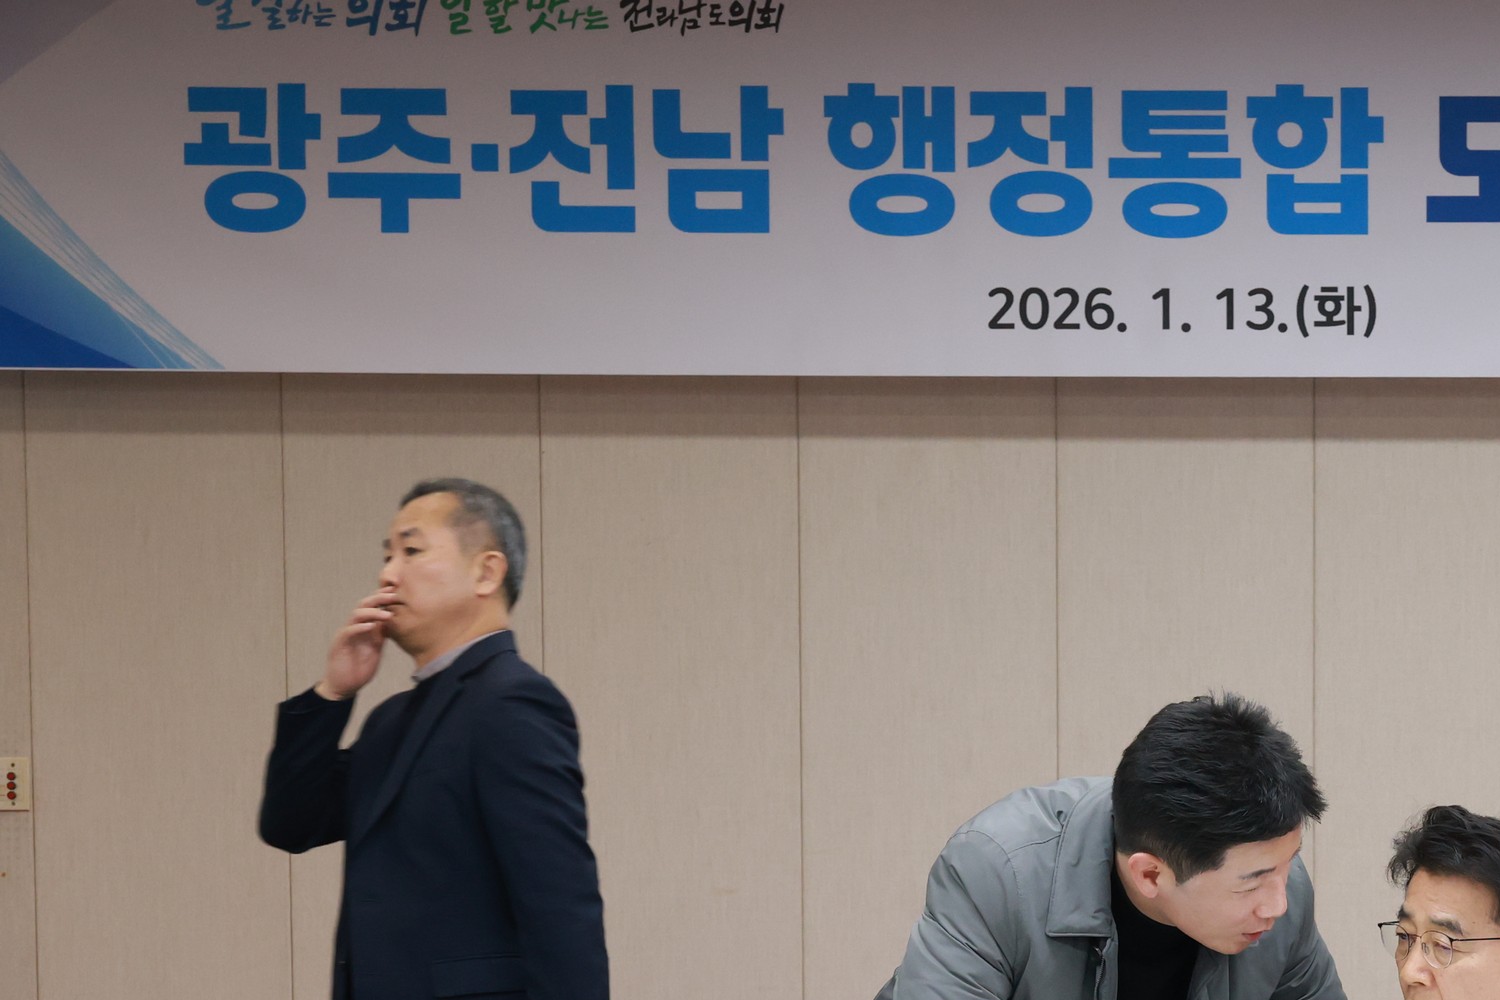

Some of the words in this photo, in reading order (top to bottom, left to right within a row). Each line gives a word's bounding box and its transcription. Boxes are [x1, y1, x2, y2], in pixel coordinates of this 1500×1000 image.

[346, 0, 427, 36] 의회
[620, 0, 784, 36] 전라남도의회
[184, 83, 784, 233] 광주·전남
[824, 83, 1384, 238] 행정통합
[988, 287, 1127, 332] 2026.
[1152, 288, 1191, 332] 1.
[1216, 285, 1376, 338] 13.(화)
